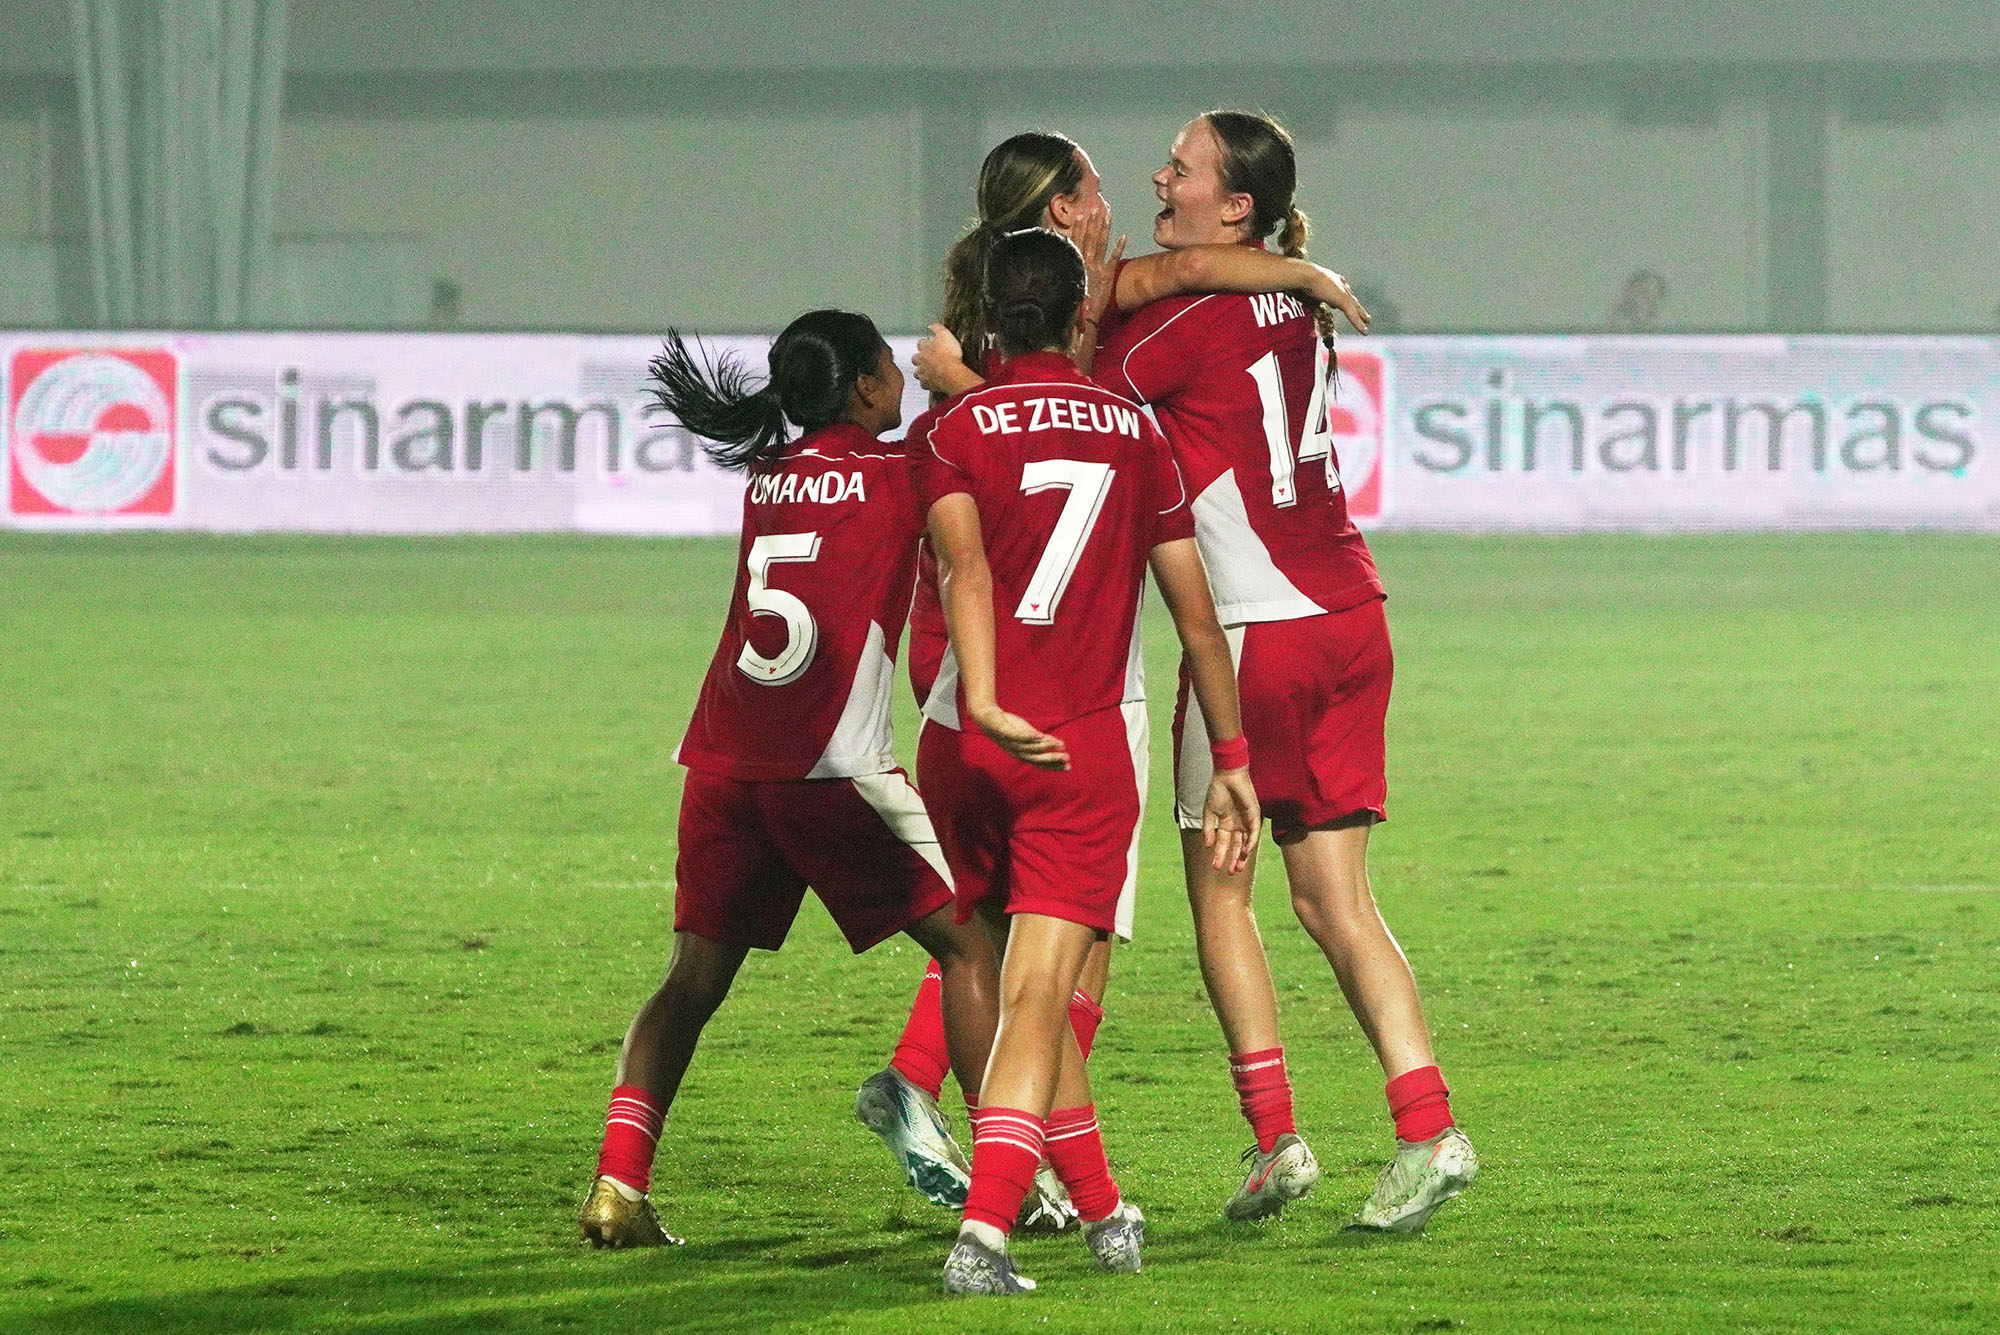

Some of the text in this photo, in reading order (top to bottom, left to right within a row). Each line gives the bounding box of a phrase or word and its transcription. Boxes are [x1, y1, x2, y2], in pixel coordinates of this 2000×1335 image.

[206, 368, 695, 472] sinarma
[971, 397, 1140, 440] DE ZEEUW
[1245, 349, 1340, 509] 14
[1410, 368, 1976, 473] sinarmas
[1013, 459, 1116, 625] 7
[736, 531, 822, 686] 5
